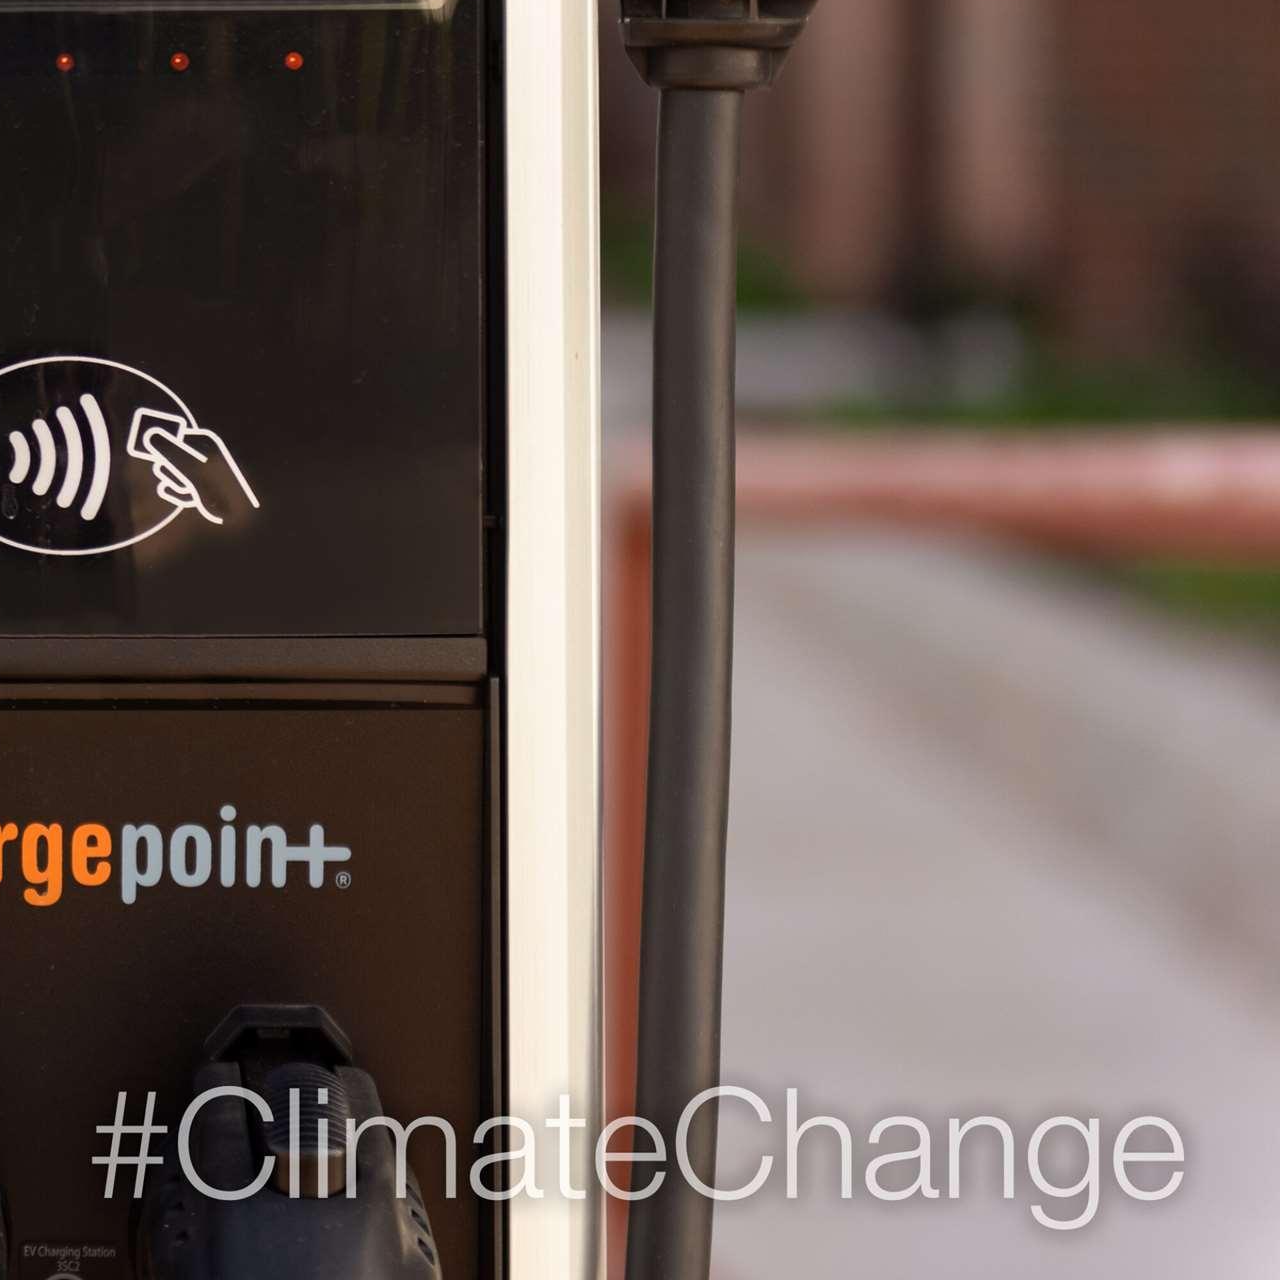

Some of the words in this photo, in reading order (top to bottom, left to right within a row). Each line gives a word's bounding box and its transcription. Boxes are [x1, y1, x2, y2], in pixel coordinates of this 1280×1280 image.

[23, 1245, 37, 1257] EV
[37, 1245, 81, 1261] Charging
[82, 1246, 117, 1258] Station
